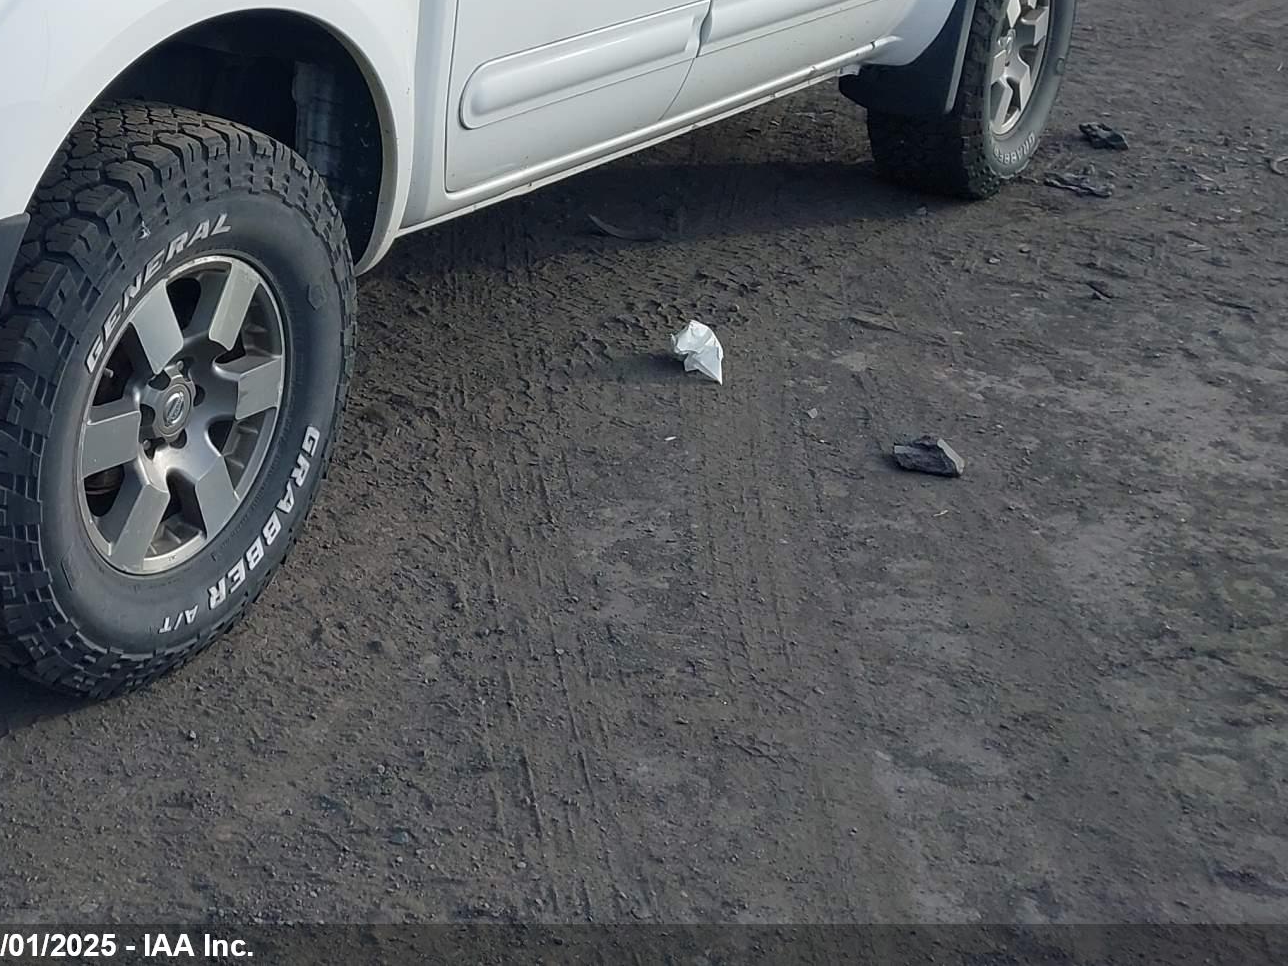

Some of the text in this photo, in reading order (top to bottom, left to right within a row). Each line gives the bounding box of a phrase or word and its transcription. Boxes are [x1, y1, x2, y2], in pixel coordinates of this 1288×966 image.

[85, 212, 232, 374] GENERAL
[158, 425, 321, 635] GRABBER A/T
